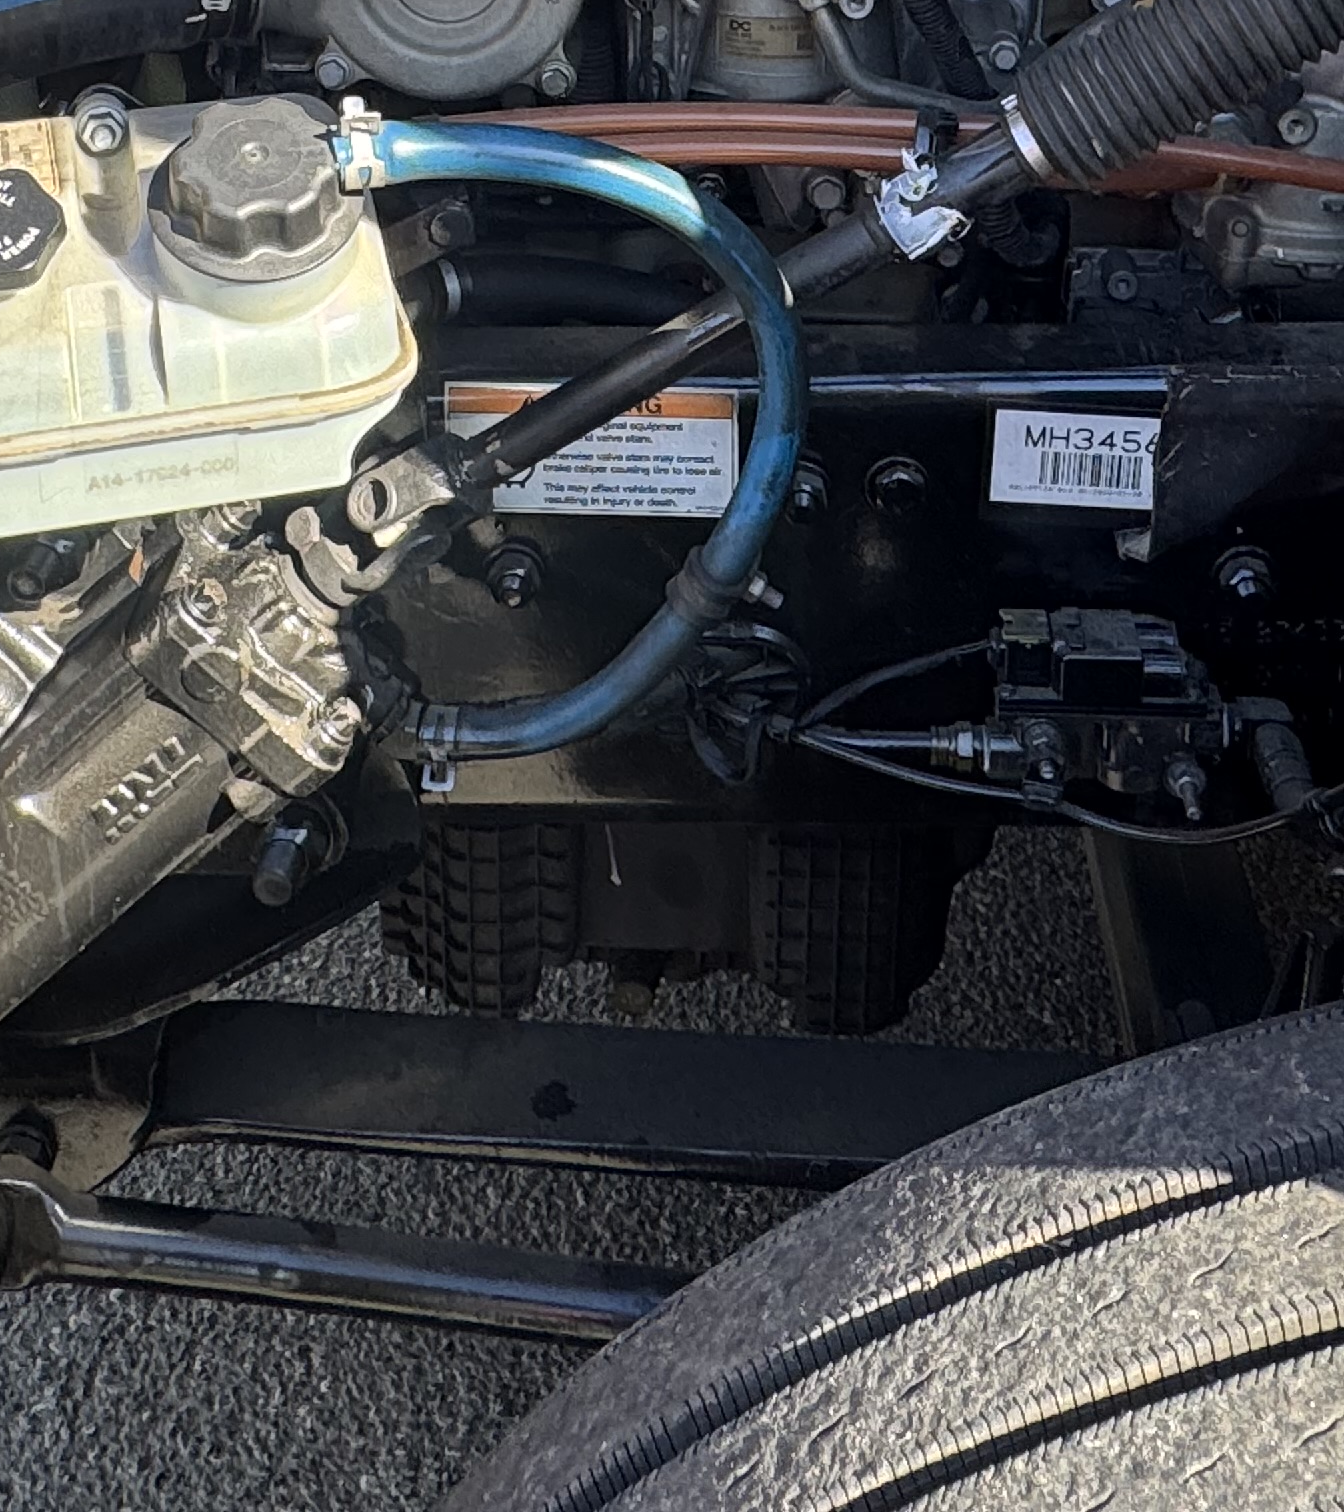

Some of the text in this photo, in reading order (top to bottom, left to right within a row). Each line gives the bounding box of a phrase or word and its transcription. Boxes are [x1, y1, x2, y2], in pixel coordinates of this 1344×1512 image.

[0, 226, 41, 261] POWER
[629, 421, 684, 433] equipment
[596, 435, 624, 443] valve
[549, 452, 715, 466] therwise valve stem may contact
[543, 462, 571, 473] brake
[574, 463, 609, 476] caliper
[610, 465, 650, 476] causing
[671, 466, 683, 476] to
[543, 482, 696, 495] This may affect vehicle control
[543, 494, 678, 508] resulting in injury or death.
